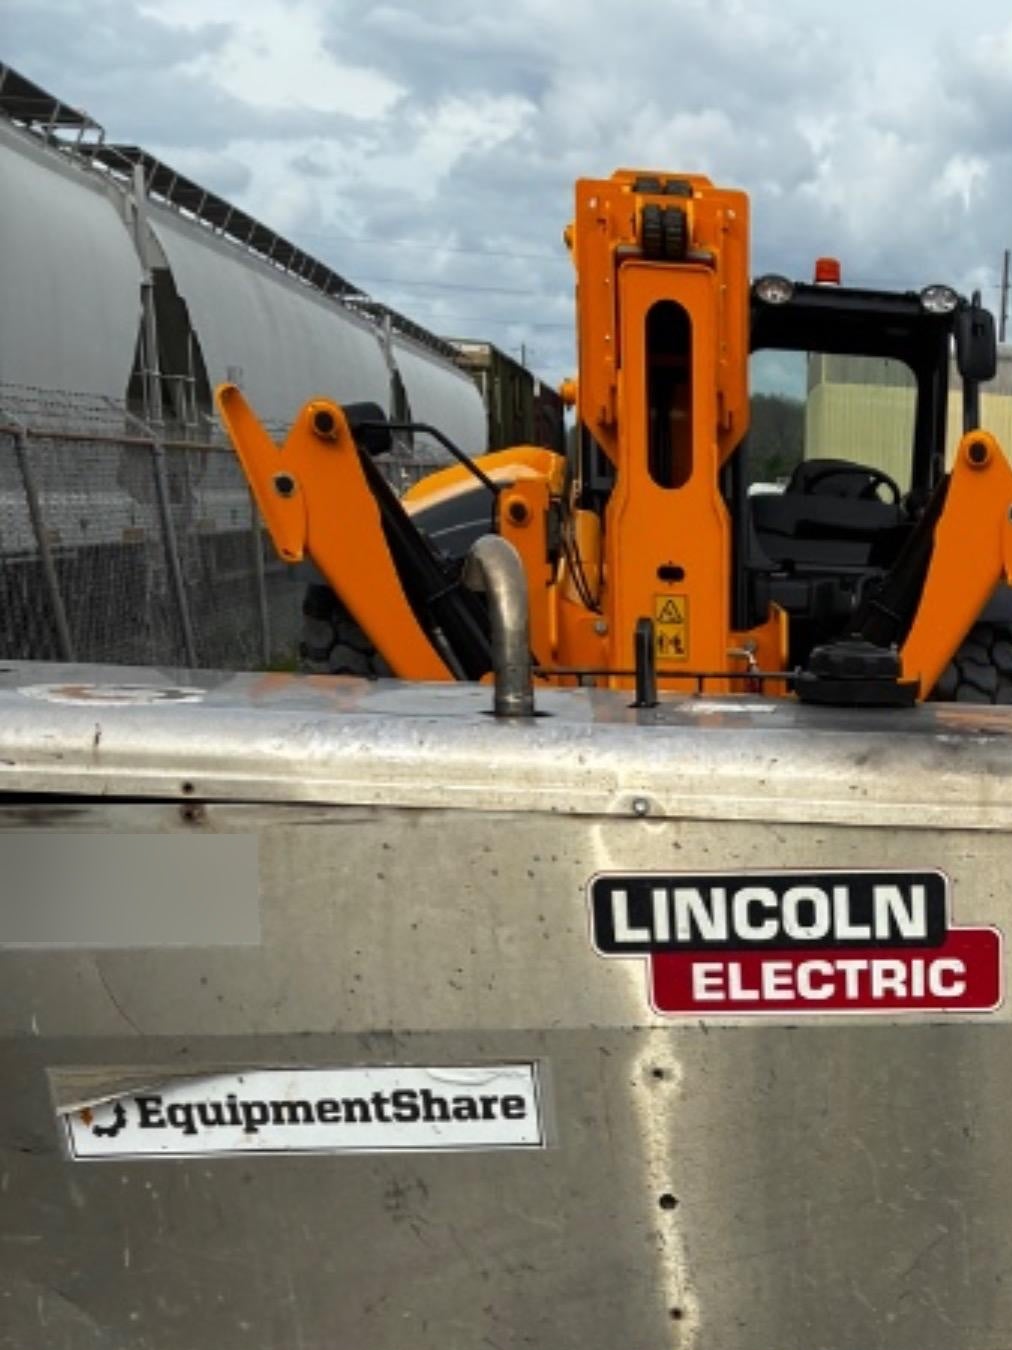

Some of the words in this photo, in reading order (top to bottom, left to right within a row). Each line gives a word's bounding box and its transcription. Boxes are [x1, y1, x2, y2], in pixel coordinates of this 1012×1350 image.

[610, 884, 929, 943] LINCOLN
[691, 958, 967, 1001] ELECTRIC
[136, 1088, 527, 1135] EquipmentShare
